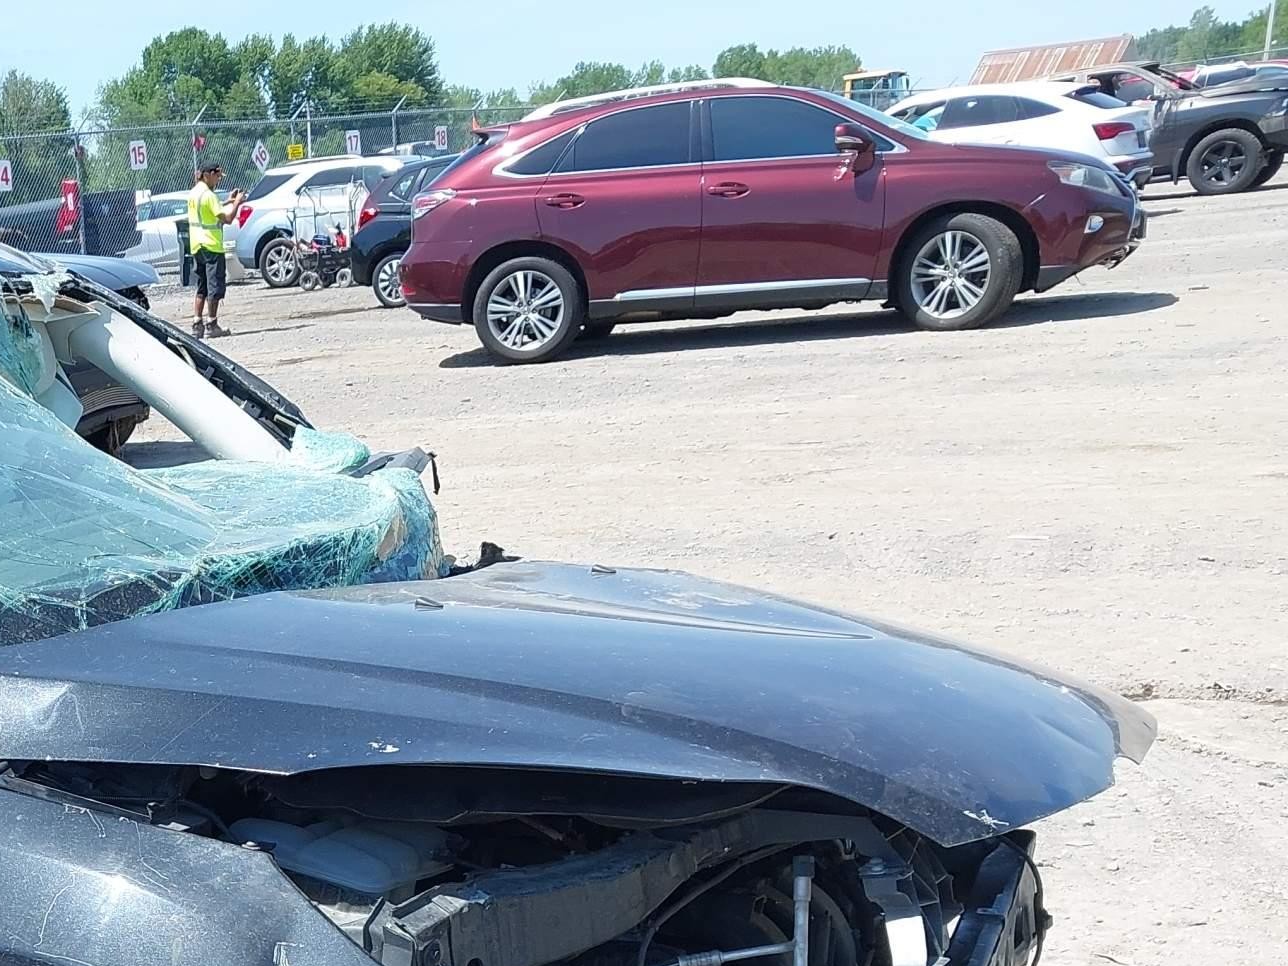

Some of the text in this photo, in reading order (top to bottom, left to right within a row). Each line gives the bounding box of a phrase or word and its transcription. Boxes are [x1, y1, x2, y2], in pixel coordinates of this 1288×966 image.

[347, 135, 359, 151] 17
[436, 130, 446, 146] 18
[132, 145, 146, 165] 15
[255, 146, 268, 167] 16
